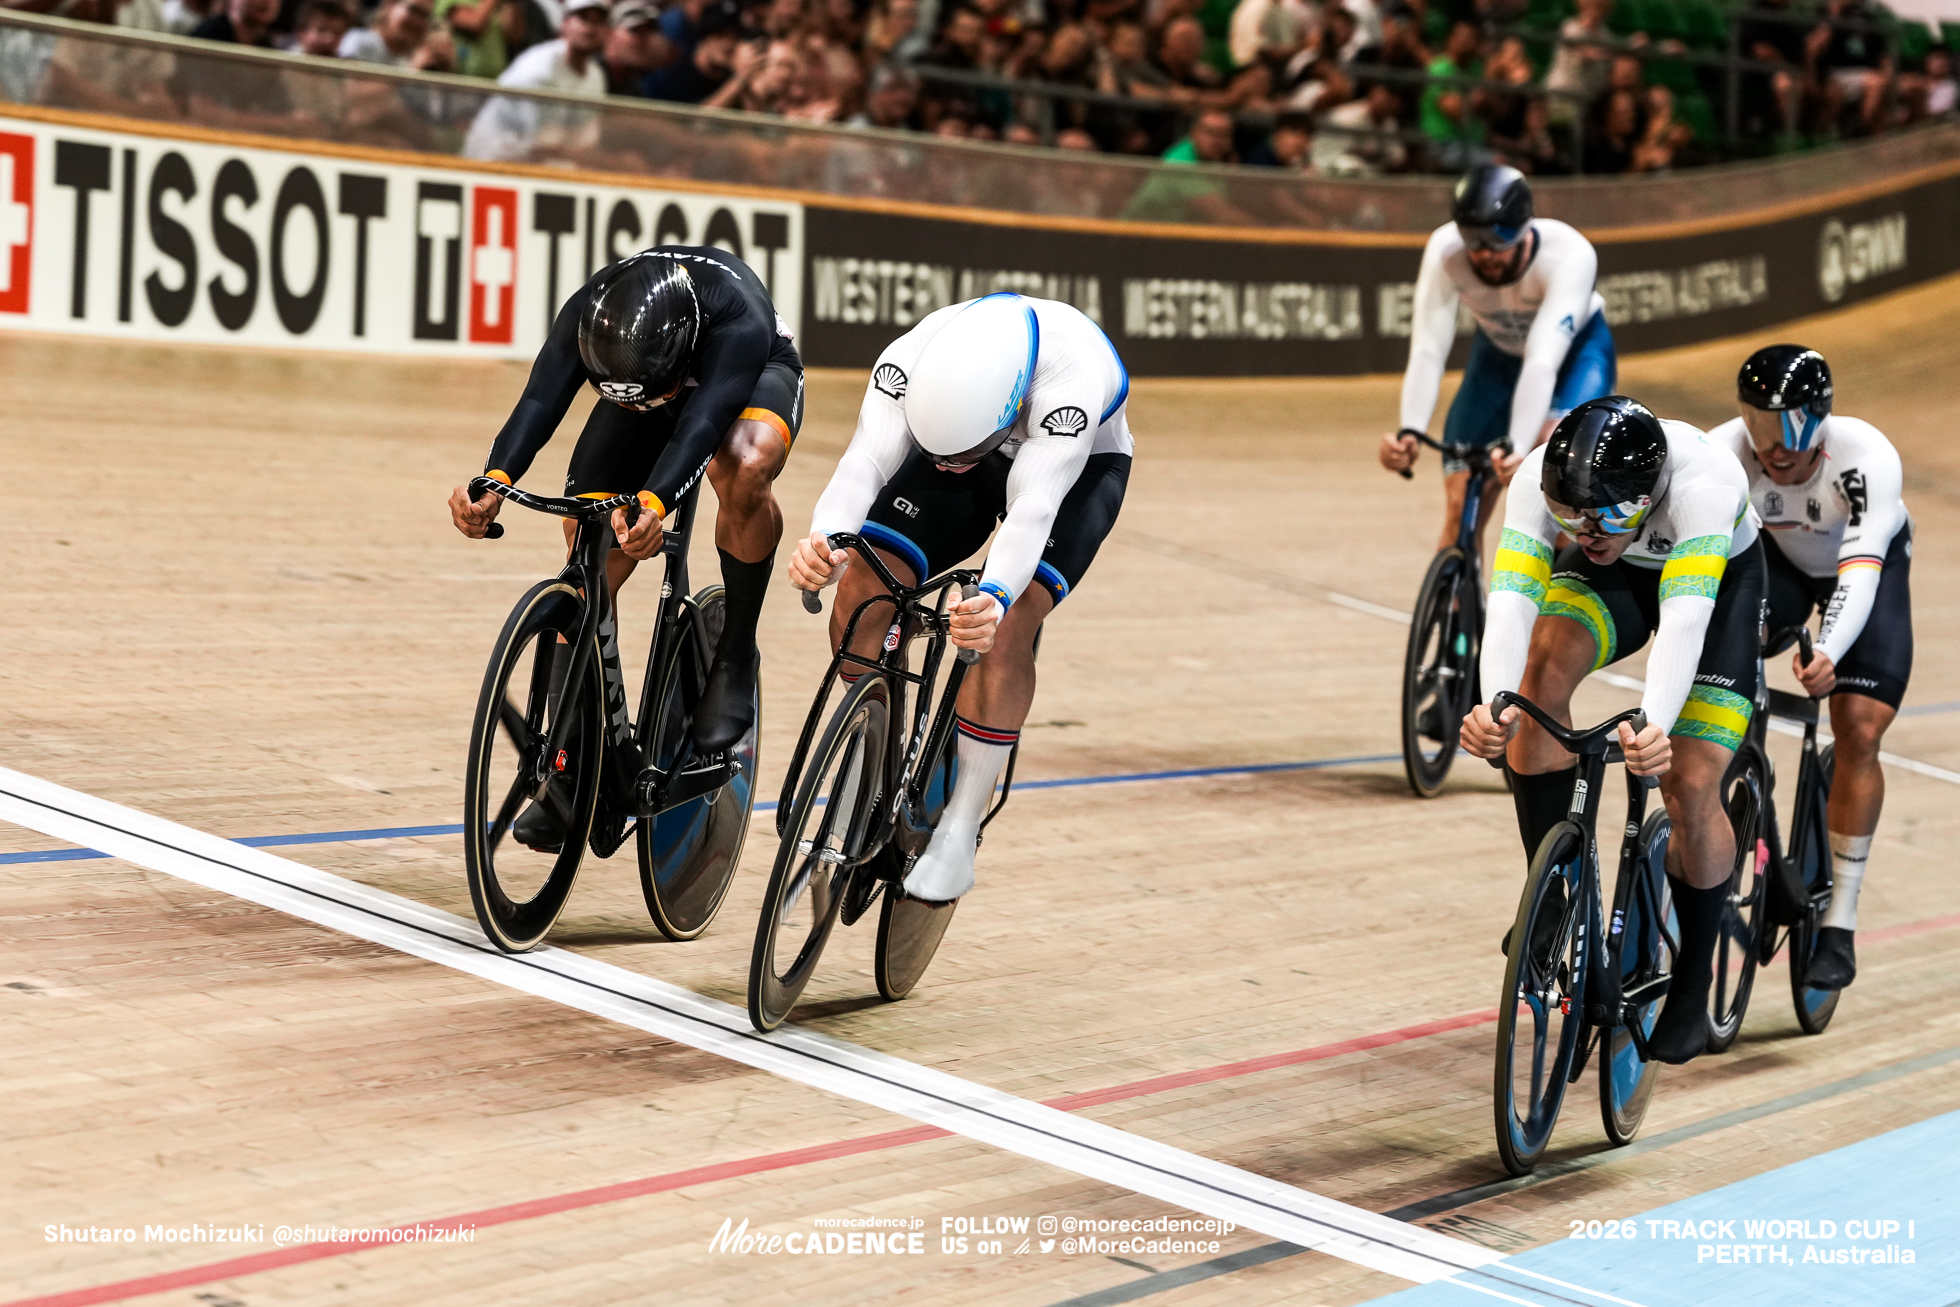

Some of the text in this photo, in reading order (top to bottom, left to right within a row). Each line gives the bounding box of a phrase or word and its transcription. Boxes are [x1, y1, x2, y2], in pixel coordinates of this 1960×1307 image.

[54, 139, 388, 337] TISSOT
[813, 256, 953, 327] WESTERN
[1123, 279, 1238, 338] WESTERN
[1243, 282, 1361, 340] AUSTRALIA
[1598, 270, 1675, 326] ESTERN
[1840, 467, 1868, 527] KTM
[1694, 673, 1737, 687] antini
[1838, 676, 1879, 689] RMANY
